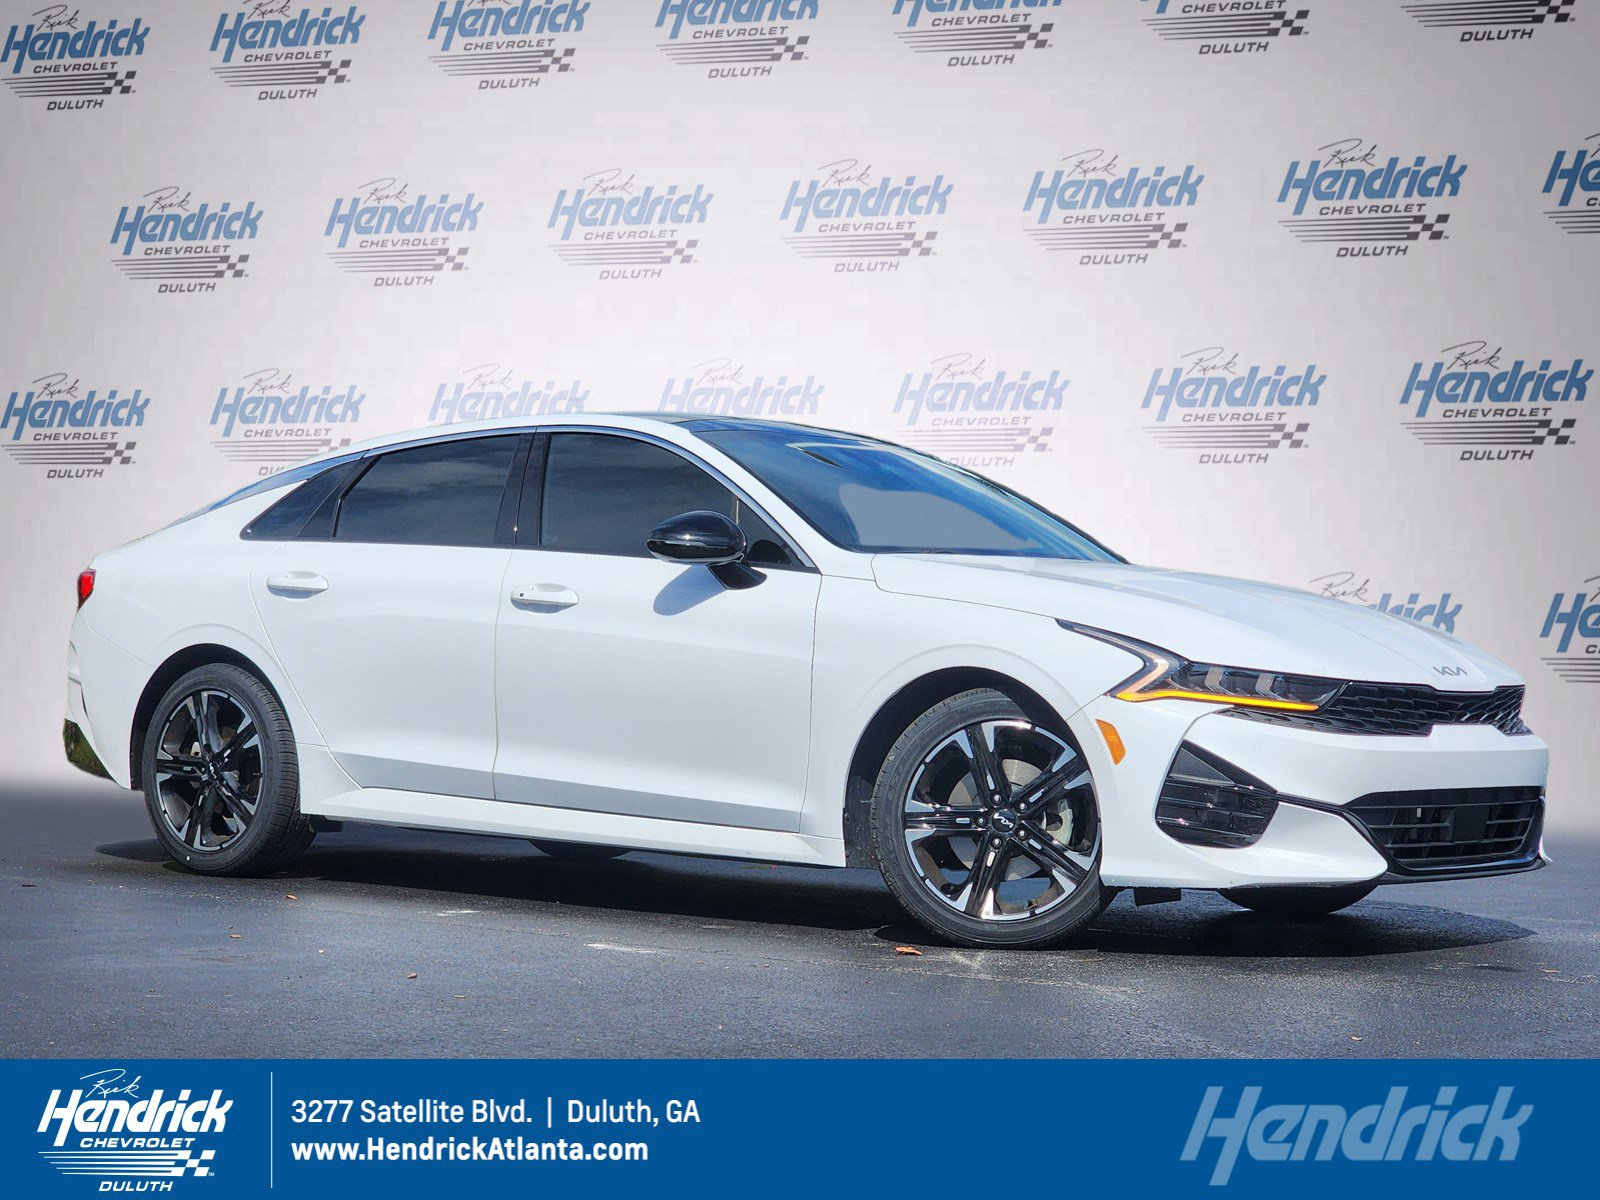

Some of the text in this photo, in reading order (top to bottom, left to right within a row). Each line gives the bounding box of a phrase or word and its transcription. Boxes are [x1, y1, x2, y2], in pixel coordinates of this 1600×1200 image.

[1181, 0, 1287, 14] CHEVROLET
[427, 0, 591, 52] Hendrick
[931, 13, 1031, 27] CHEVROLET
[209, 6, 366, 63] Hendrick
[692, 26, 788, 40] CHEVROLET
[1459, 28, 1534, 42] DULUTH
[0, 18, 150, 74] Hendrick
[463, 38, 556, 51] CHEVROLET
[1198, 41, 1269, 55] DULUTH
[244, 51, 332, 63] CHEVROLET
[947, 54, 1015, 67] DULUTH
[33, 62, 118, 74] CHEVROLET
[707, 66, 773, 79] DULUTH
[478, 77, 540, 90] DULUTH
[258, 89, 318, 101] DULUTH
[46, 99, 104, 111] DULUTH
[1277, 154, 1468, 216] Hendrick
[1022, 165, 1205, 225] Hendrick
[779, 174, 954, 233] Hendrick
[1318, 203, 1427, 216] CHEVROLET
[547, 184, 714, 240] Hendrick
[1062, 212, 1165, 225] CHEVROLET
[324, 193, 484, 248] Hendrick
[818, 221, 916, 233] CHEVROLET
[110, 201, 264, 256] Hendrick
[584, 229, 678, 241] CHEVROLET
[359, 237, 449, 248] CHEVROLET
[144, 244, 230, 256] CHEVROLET
[1336, 245, 1409, 258] DULUTH
[1079, 253, 1149, 266] DULUTH
[834, 261, 900, 273] DULUTH
[599, 268, 662, 280] DULUTH
[158, 282, 216, 294] DULUTH
[373, 276, 435, 287] DULUTH
[1140, 365, 1327, 422] Hendrick
[1400, 359, 1595, 418] Hendrick
[427, 380, 591, 424] Hendrick
[657, 375, 825, 416] Hendrick
[892, 370, 1071, 426] Hendrick
[0, 389, 151, 441] Hendrick
[209, 385, 366, 437] Hendrick
[1182, 412, 1286, 423] CHEVROLET
[1442, 408, 1552, 418] CHEVROLET
[931, 416, 1031, 427] CHEVROLET
[33, 432, 118, 441] CHEVROLET
[244, 428, 332, 438] CHEVROLET
[1198, 454, 1269, 464] DULUTH
[1460, 450, 1534, 461] DULUTH
[948, 457, 1016, 468] DULUTH
[46, 468, 104, 479] DULUTH
